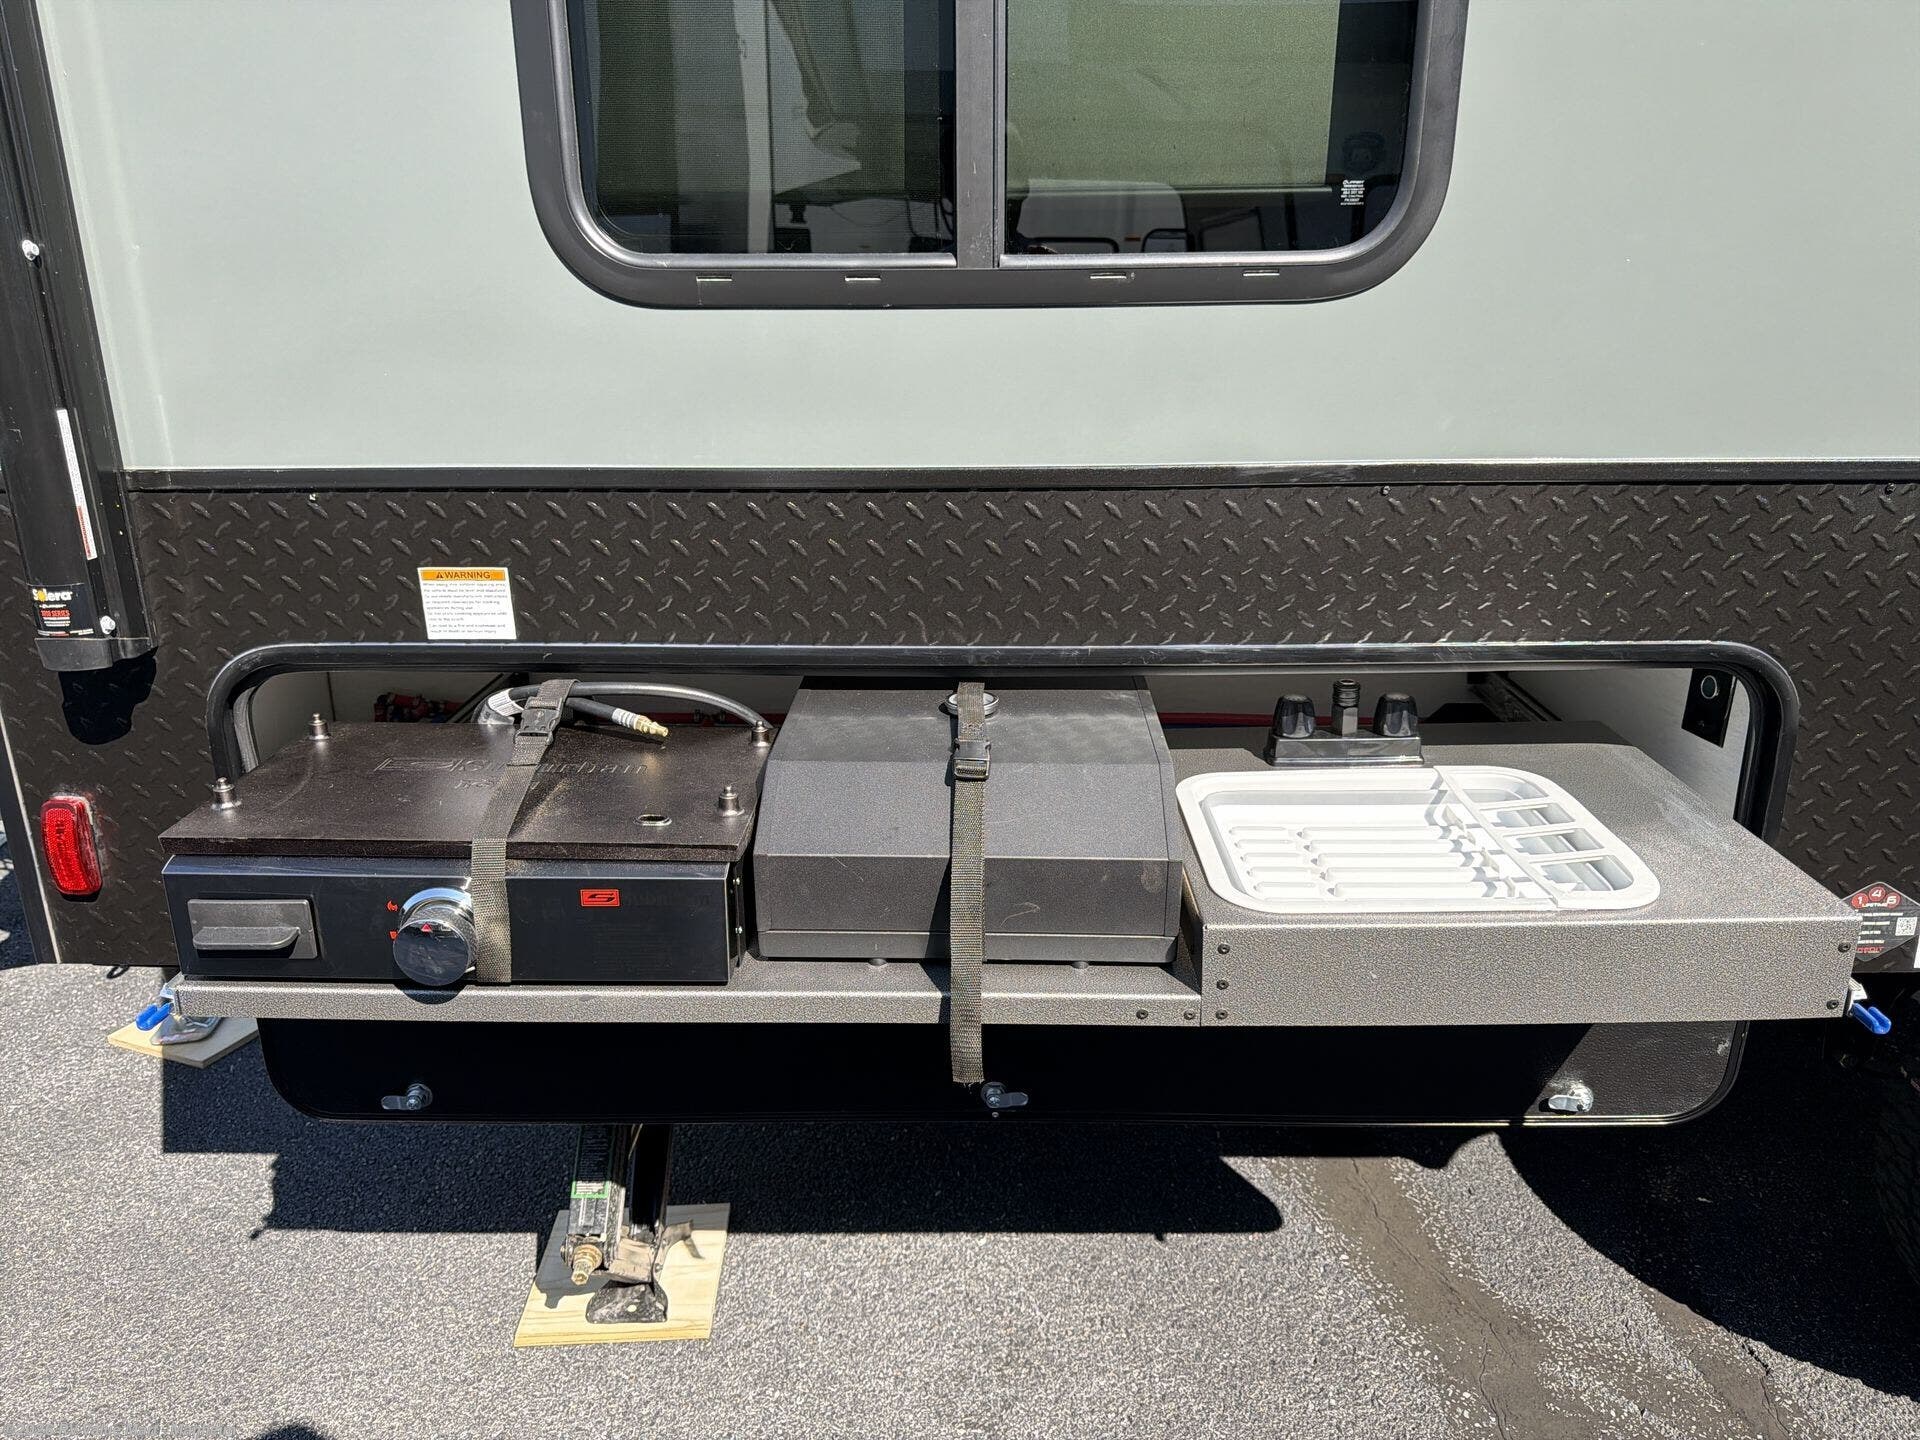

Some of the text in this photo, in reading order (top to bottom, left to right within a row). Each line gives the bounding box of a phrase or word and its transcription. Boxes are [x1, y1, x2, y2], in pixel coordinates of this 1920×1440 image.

[445, 571, 491, 579] WARNING
[32, 588, 73, 602] Solera
[1887, 896, 1897, 904] 6
